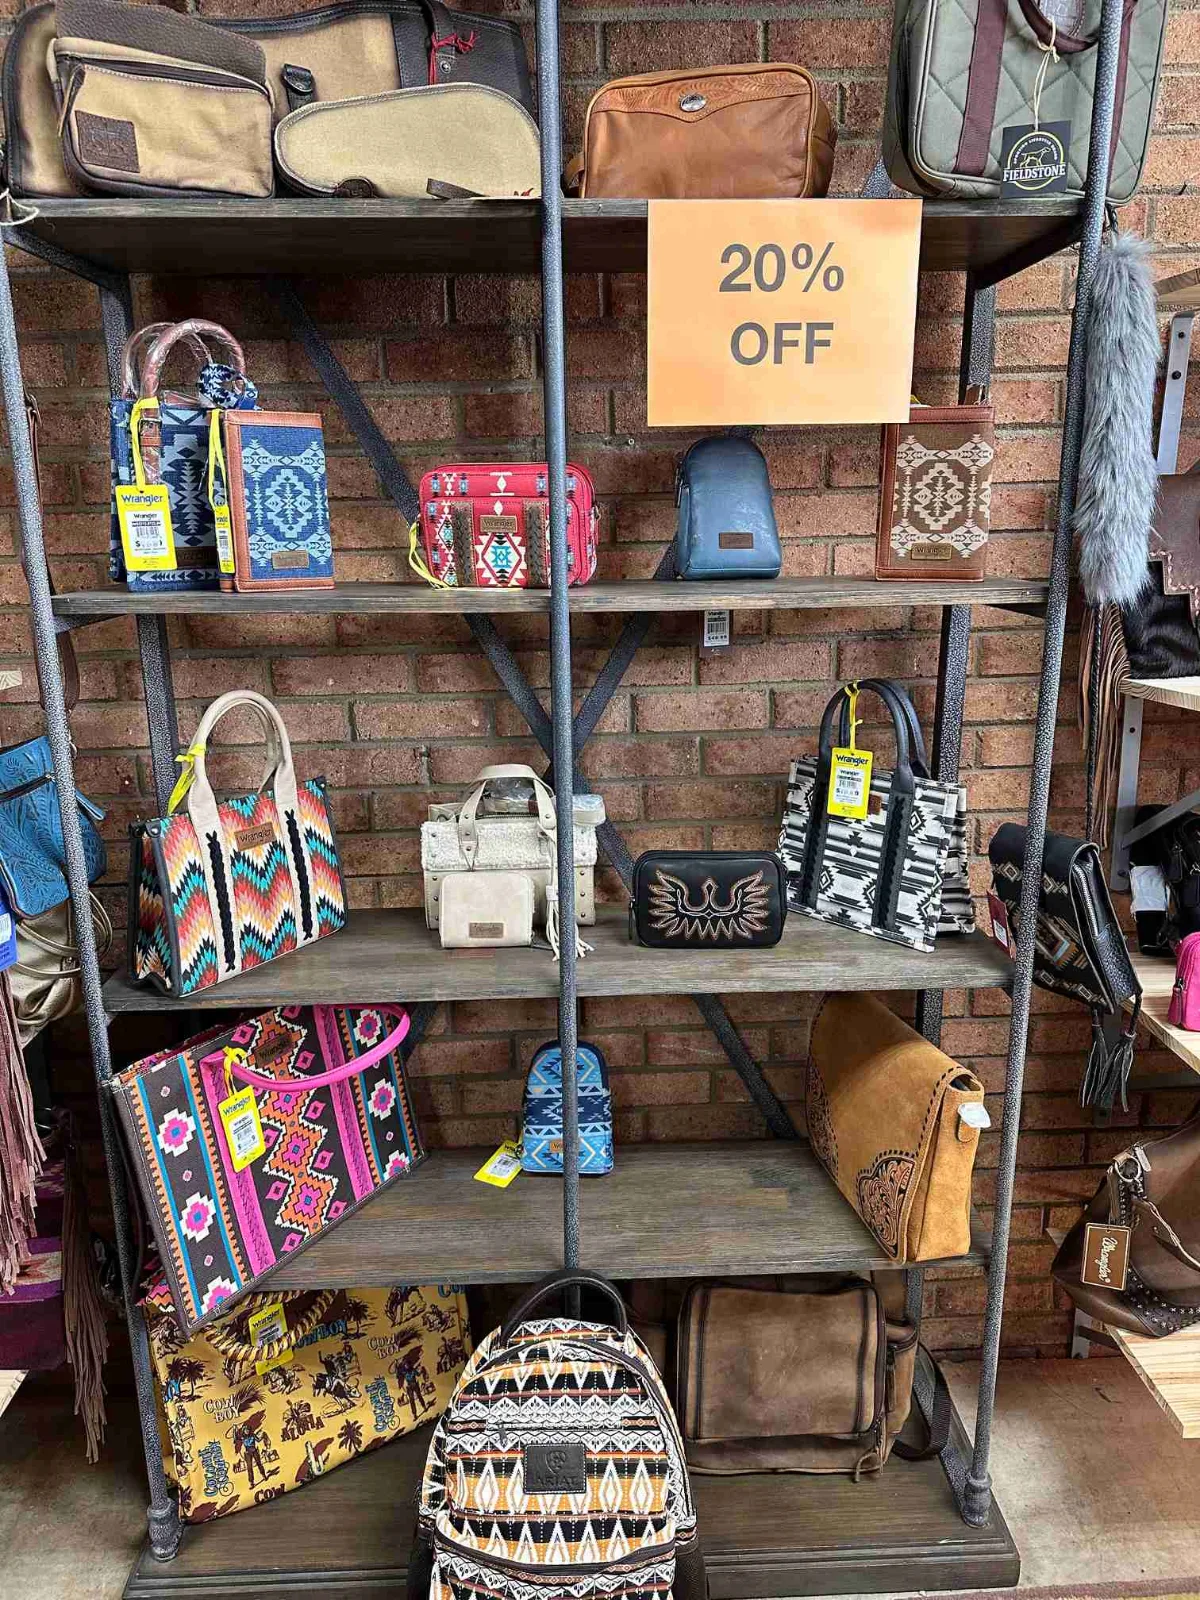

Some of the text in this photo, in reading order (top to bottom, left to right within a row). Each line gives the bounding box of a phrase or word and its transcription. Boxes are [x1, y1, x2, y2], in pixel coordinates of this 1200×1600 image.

[1003, 163, 1067, 182] FIELDSTONE
[719, 242, 844, 292] 20%
[730, 322, 834, 365] OFF
[121, 494, 164, 507] Wrangler
[836, 754, 869, 767] Wrangler
[239, 829, 271, 842] Wrangler
[223, 1096, 251, 1116] Wrangler
[1095, 1237, 1118, 1281] Wrangler
[252, 1309, 280, 1328] Wrangler
[203, 1397, 236, 1414] COW
[214, 1406, 241, 1423] BOY
[254, 1483, 286, 1504] COW
